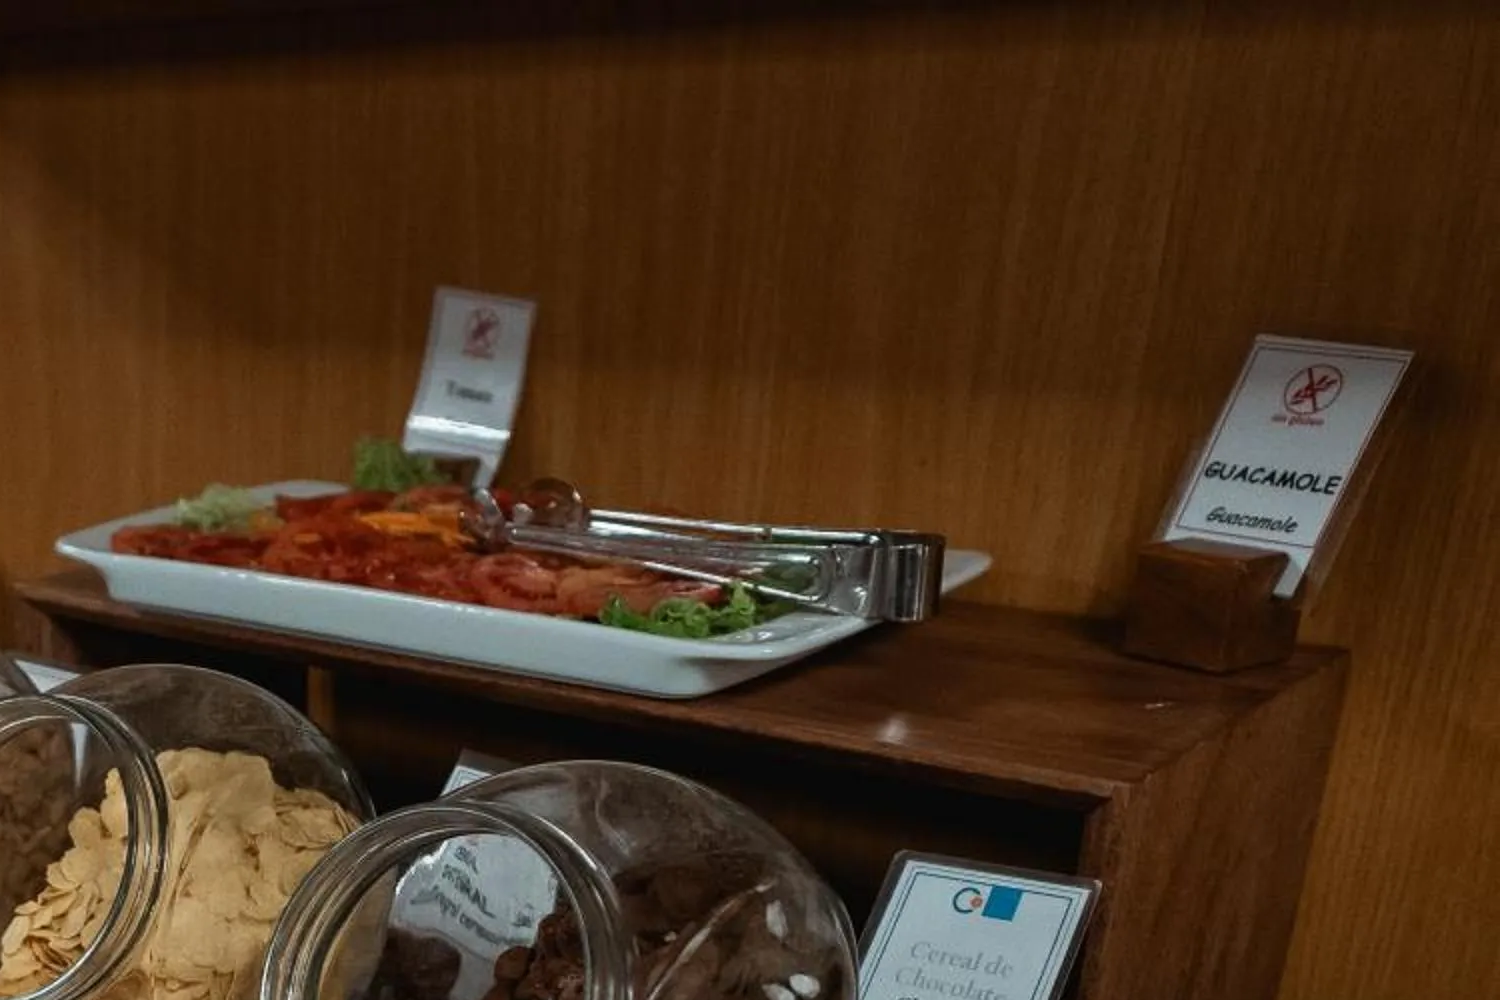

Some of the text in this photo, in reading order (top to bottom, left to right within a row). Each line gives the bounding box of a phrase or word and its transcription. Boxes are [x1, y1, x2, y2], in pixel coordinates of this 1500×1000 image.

[1204, 461, 1342, 496] GUACAMOLE
[1206, 505, 1299, 533] Guacamole
[910, 940, 1014, 978] Cereal de
